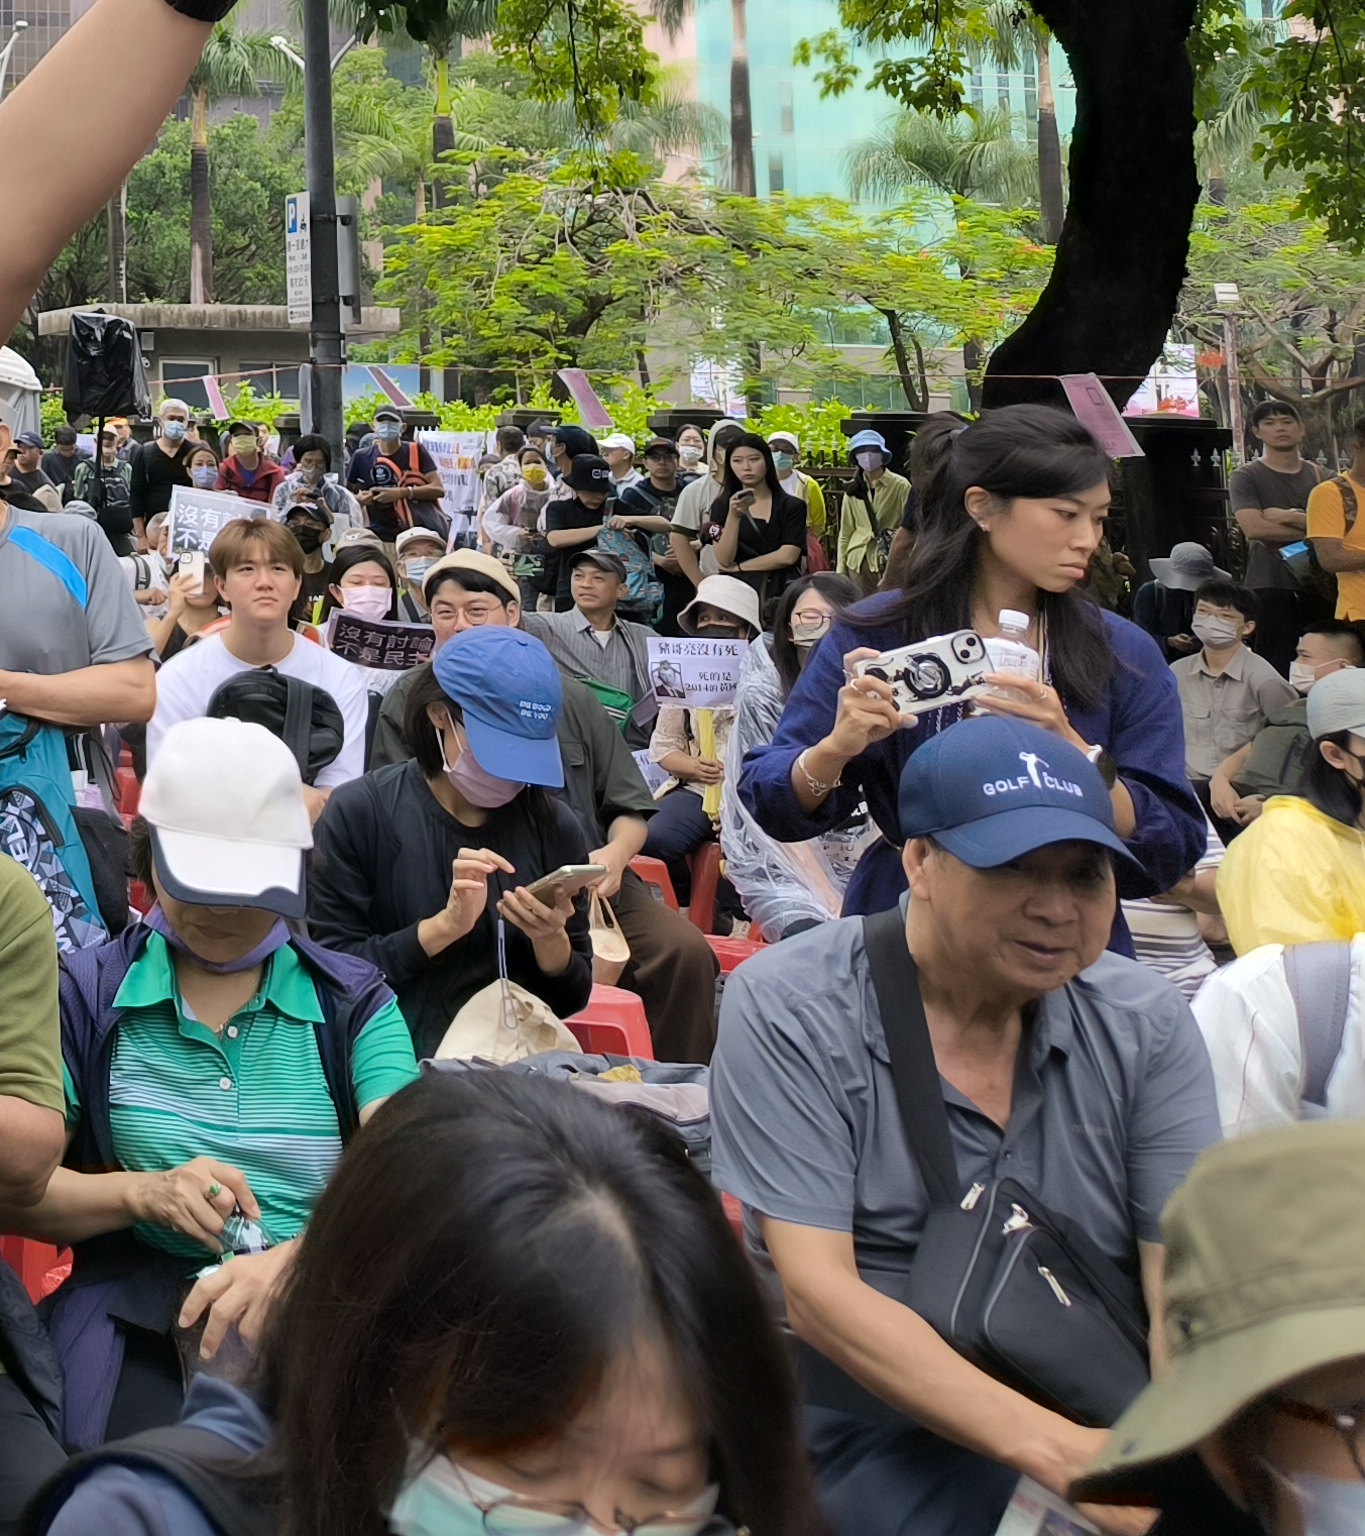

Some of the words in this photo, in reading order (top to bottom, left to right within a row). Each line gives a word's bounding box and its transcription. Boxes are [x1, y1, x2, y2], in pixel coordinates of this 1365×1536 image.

[338, 623, 434, 652] 沒有討論
[335, 639, 429, 666] 不是民主
[658, 642, 739, 656] 豬哥亮沒有死
[698, 671, 732, 682] 死的是
[982, 776, 1030, 796] GOLF
[1044, 775, 1084, 797] CLUB
